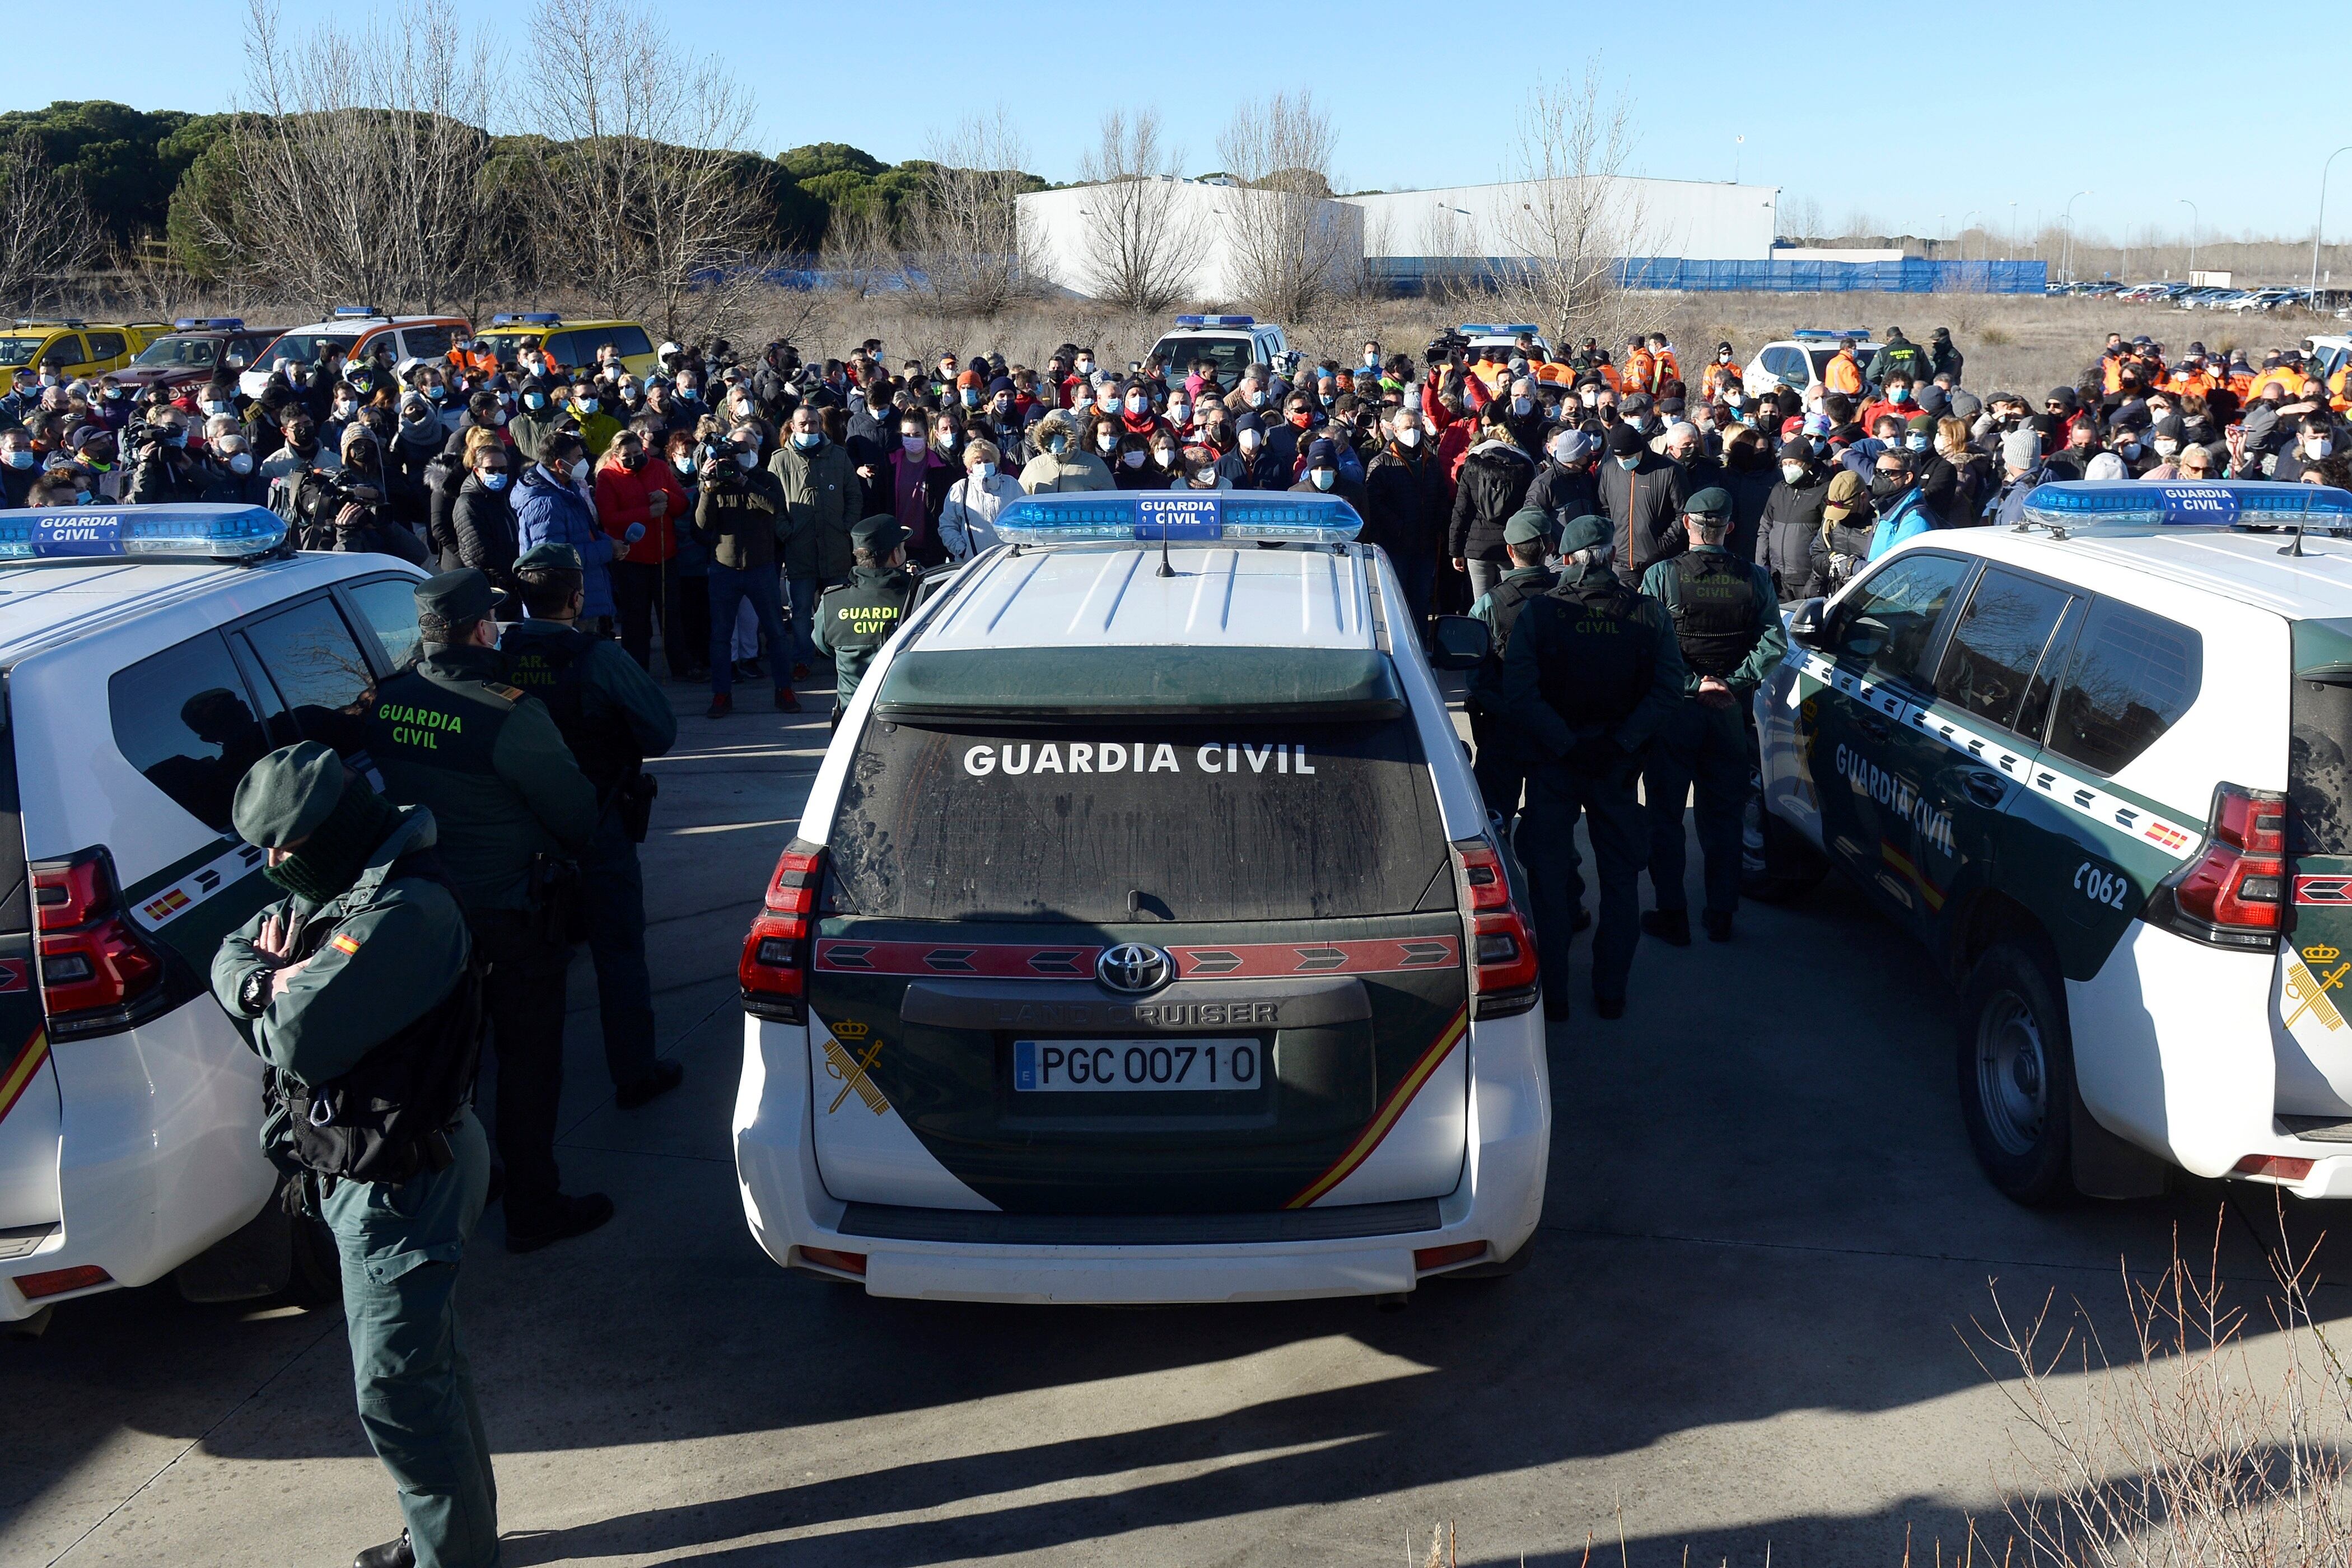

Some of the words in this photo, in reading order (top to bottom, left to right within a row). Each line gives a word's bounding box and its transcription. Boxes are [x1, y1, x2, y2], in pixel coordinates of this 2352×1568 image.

[2165, 489, 2232, 498] GUARDIA
[1140, 501, 1215, 511] GUARDIA
[2183, 500, 2223, 510] CIVIL
[40, 516, 118, 528] GUARDIA
[1155, 513, 1201, 524] CIVIL
[53, 529, 99, 540] CIVIL
[1696, 587, 1733, 598] CIVIL
[838, 608, 898, 620] GUARDI
[853, 621, 885, 634] CIVI
[1575, 622, 1620, 634] CIVIL
[511, 671, 557, 684] CIVIL
[379, 704, 461, 734] GUARDIA
[393, 727, 437, 749] CIVIL
[964, 743, 1180, 776] GUARDIA
[1197, 743, 1315, 774] CIVIL
[1836, 744, 1908, 821] GUARDIA
[1914, 797, 1952, 858] CIVIL
[2087, 869, 2127, 911] 062
[994, 1003, 1091, 1025] LAND
[1108, 1001, 1278, 1026] CRUISER
[1043, 1047, 1114, 1084] PGC
